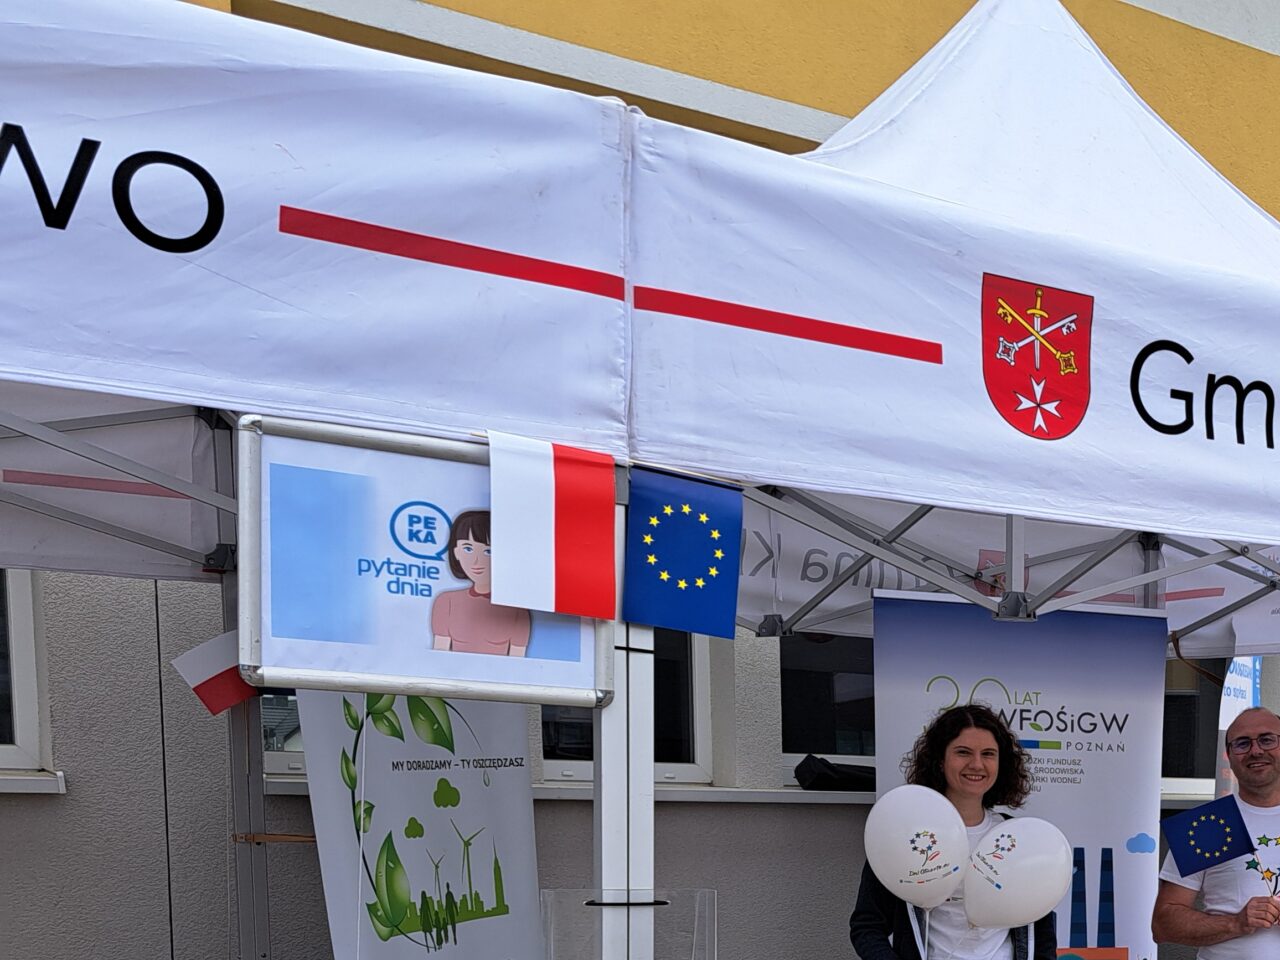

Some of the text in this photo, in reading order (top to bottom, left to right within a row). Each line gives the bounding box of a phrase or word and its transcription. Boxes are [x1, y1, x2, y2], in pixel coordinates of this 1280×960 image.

[408, 514, 437, 530] PE
[408, 529, 437, 545] KA
[358, 557, 440, 581] pytanie
[387, 577, 433, 598] dnia
[1014, 691, 1041, 706] LAT
[1066, 741, 1126, 753] POZNAŃ
[392, 761, 405, 772] MY
[407, 760, 453, 772] DORADZAMY
[461, 759, 471, 769] TY
[472, 757, 525, 771] OSZCZĘDZASZ
[1046, 757, 1082, 766] FUNDUSZ
[1034, 766, 1085, 775] ŚRODOWISKA
[1050, 776, 1082, 785] WODNEJ
